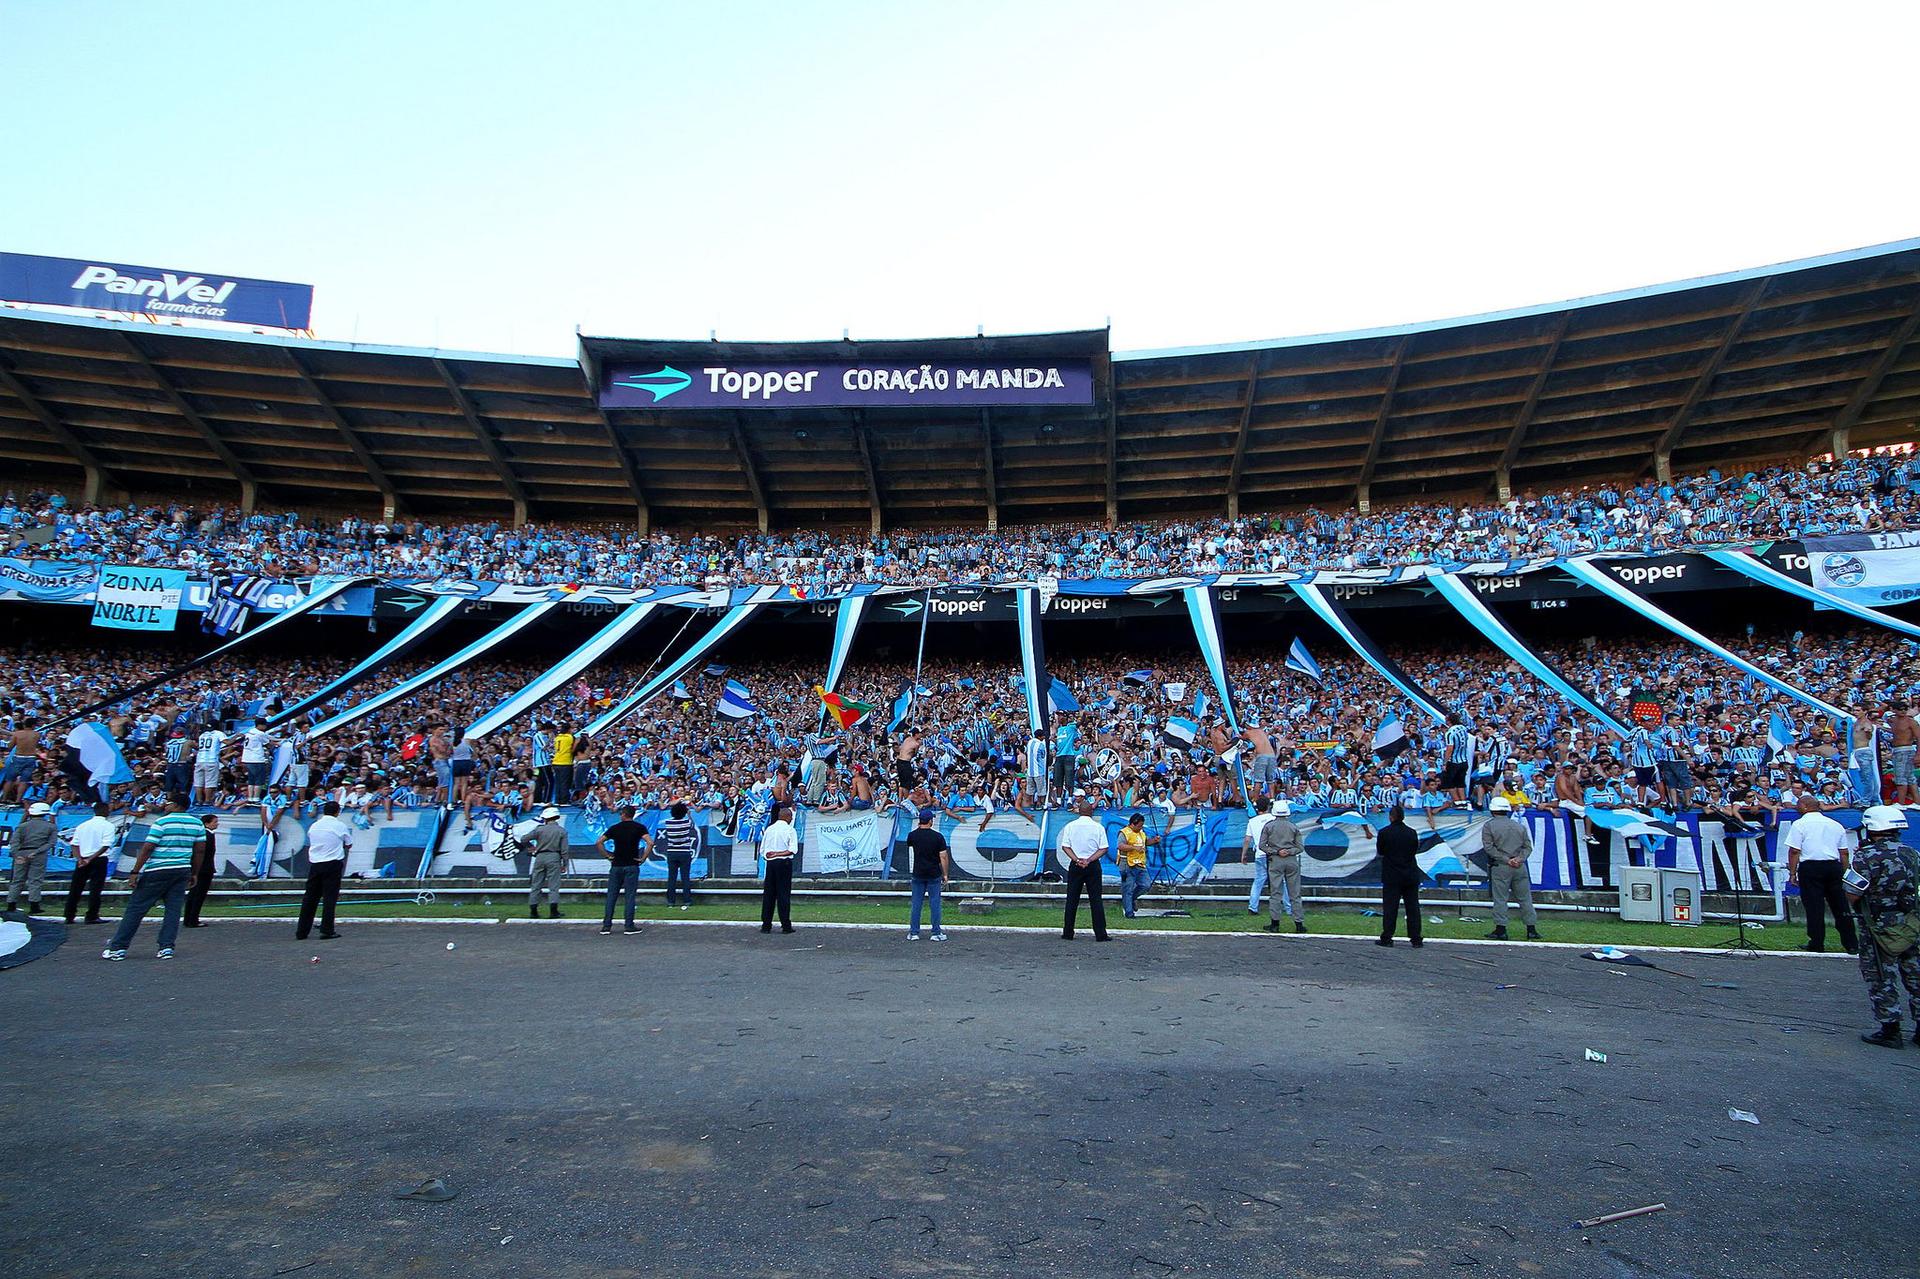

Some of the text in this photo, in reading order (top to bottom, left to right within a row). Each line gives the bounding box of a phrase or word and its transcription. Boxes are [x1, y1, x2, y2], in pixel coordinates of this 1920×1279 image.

[71, 265, 237, 304] PanVel
[145, 298, 227, 317] farmácias
[703, 367, 819, 399] Topper
[842, 364, 1064, 394] CORAÇÃO MANDA
[104, 573, 165, 592] ZONA
[95, 600, 163, 624] NORTE
[928, 599, 986, 616] Topper
[820, 825, 844, 833] NOVA
[1675, 907, 1689, 920] H
